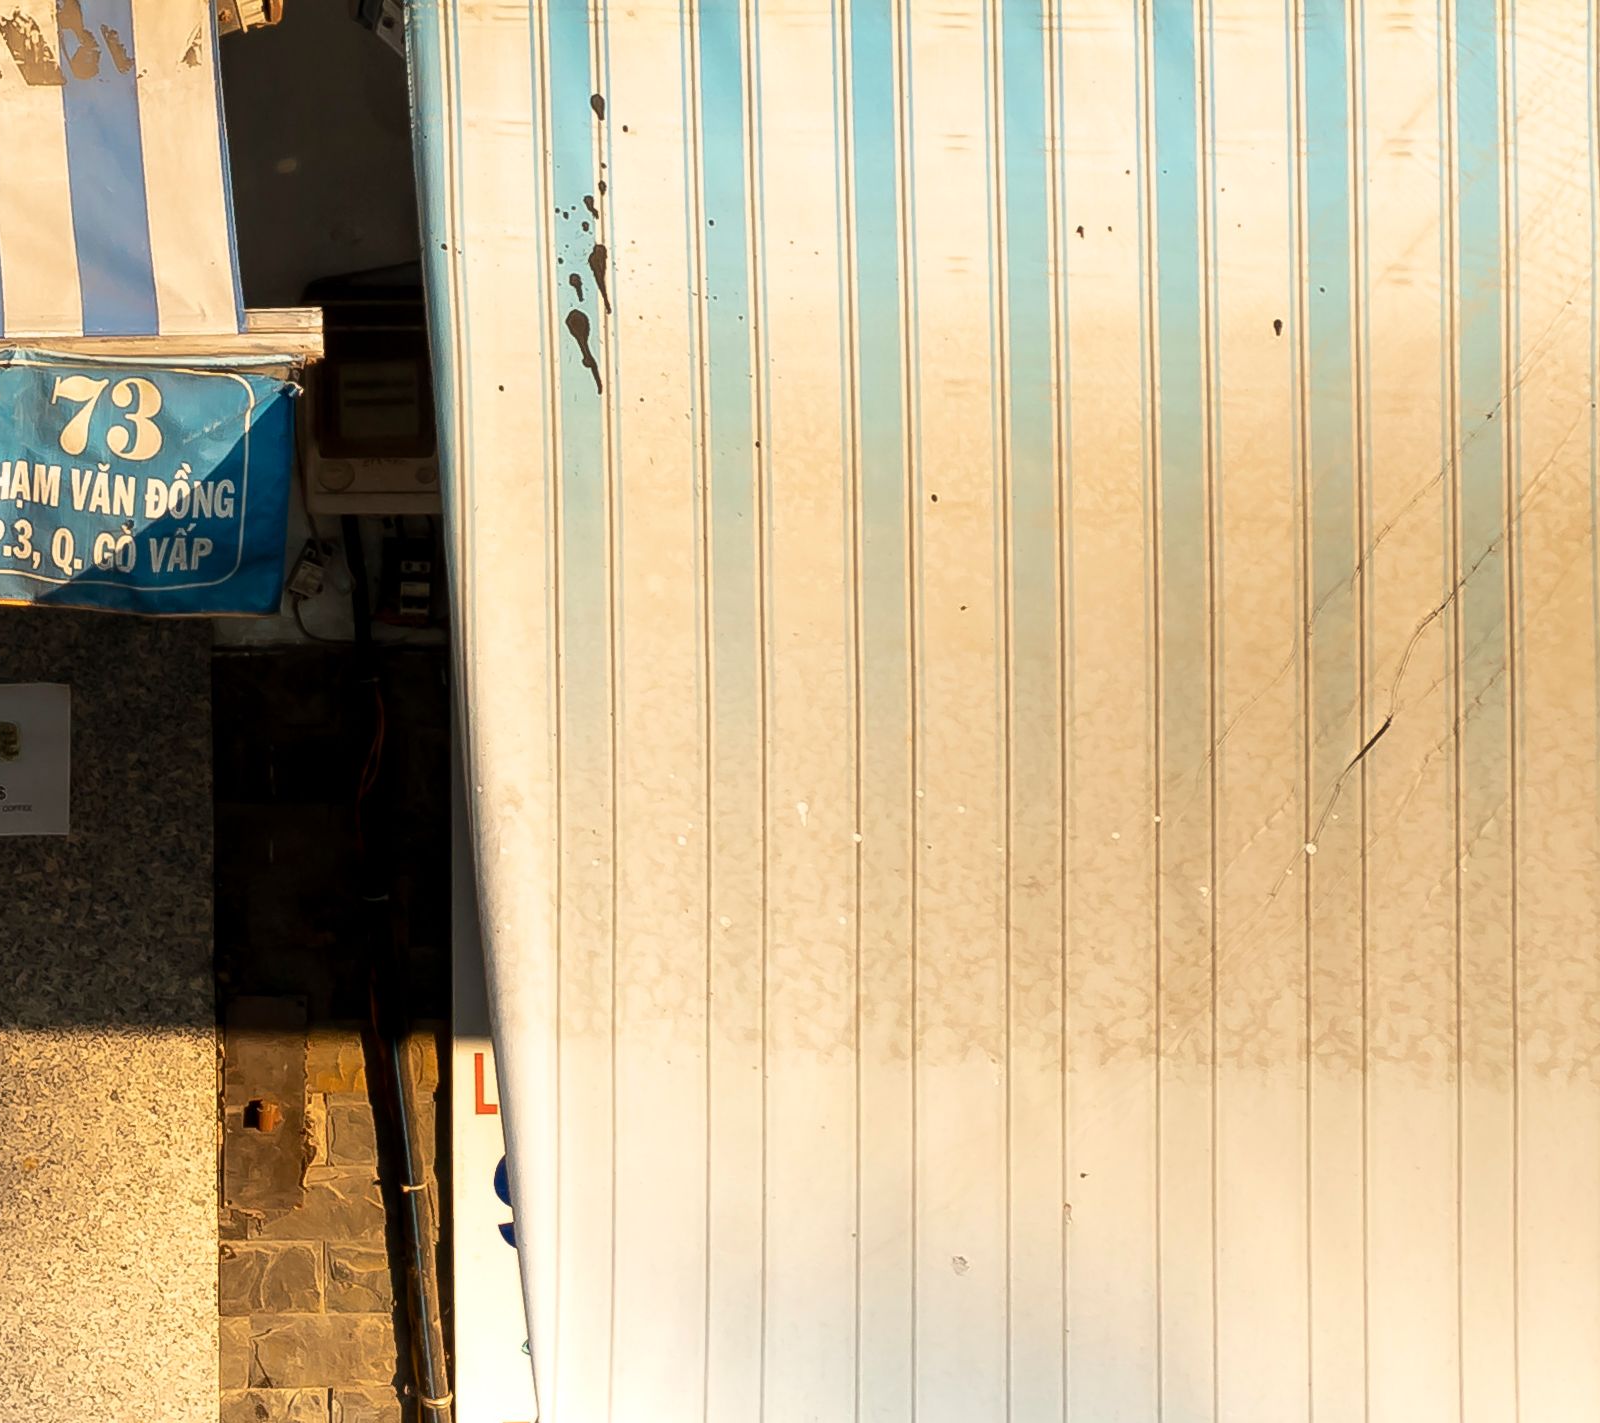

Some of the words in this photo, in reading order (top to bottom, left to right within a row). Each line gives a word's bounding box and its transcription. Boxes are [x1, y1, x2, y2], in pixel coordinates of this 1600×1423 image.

[51, 375, 163, 461] 73
[71, 463, 136, 517] VĂN
[144, 463, 235, 519] ĐỒNG
[52, 528, 84, 576] Q.
[93, 520, 136, 574] GÒ
[150, 523, 213, 573] VẤP
